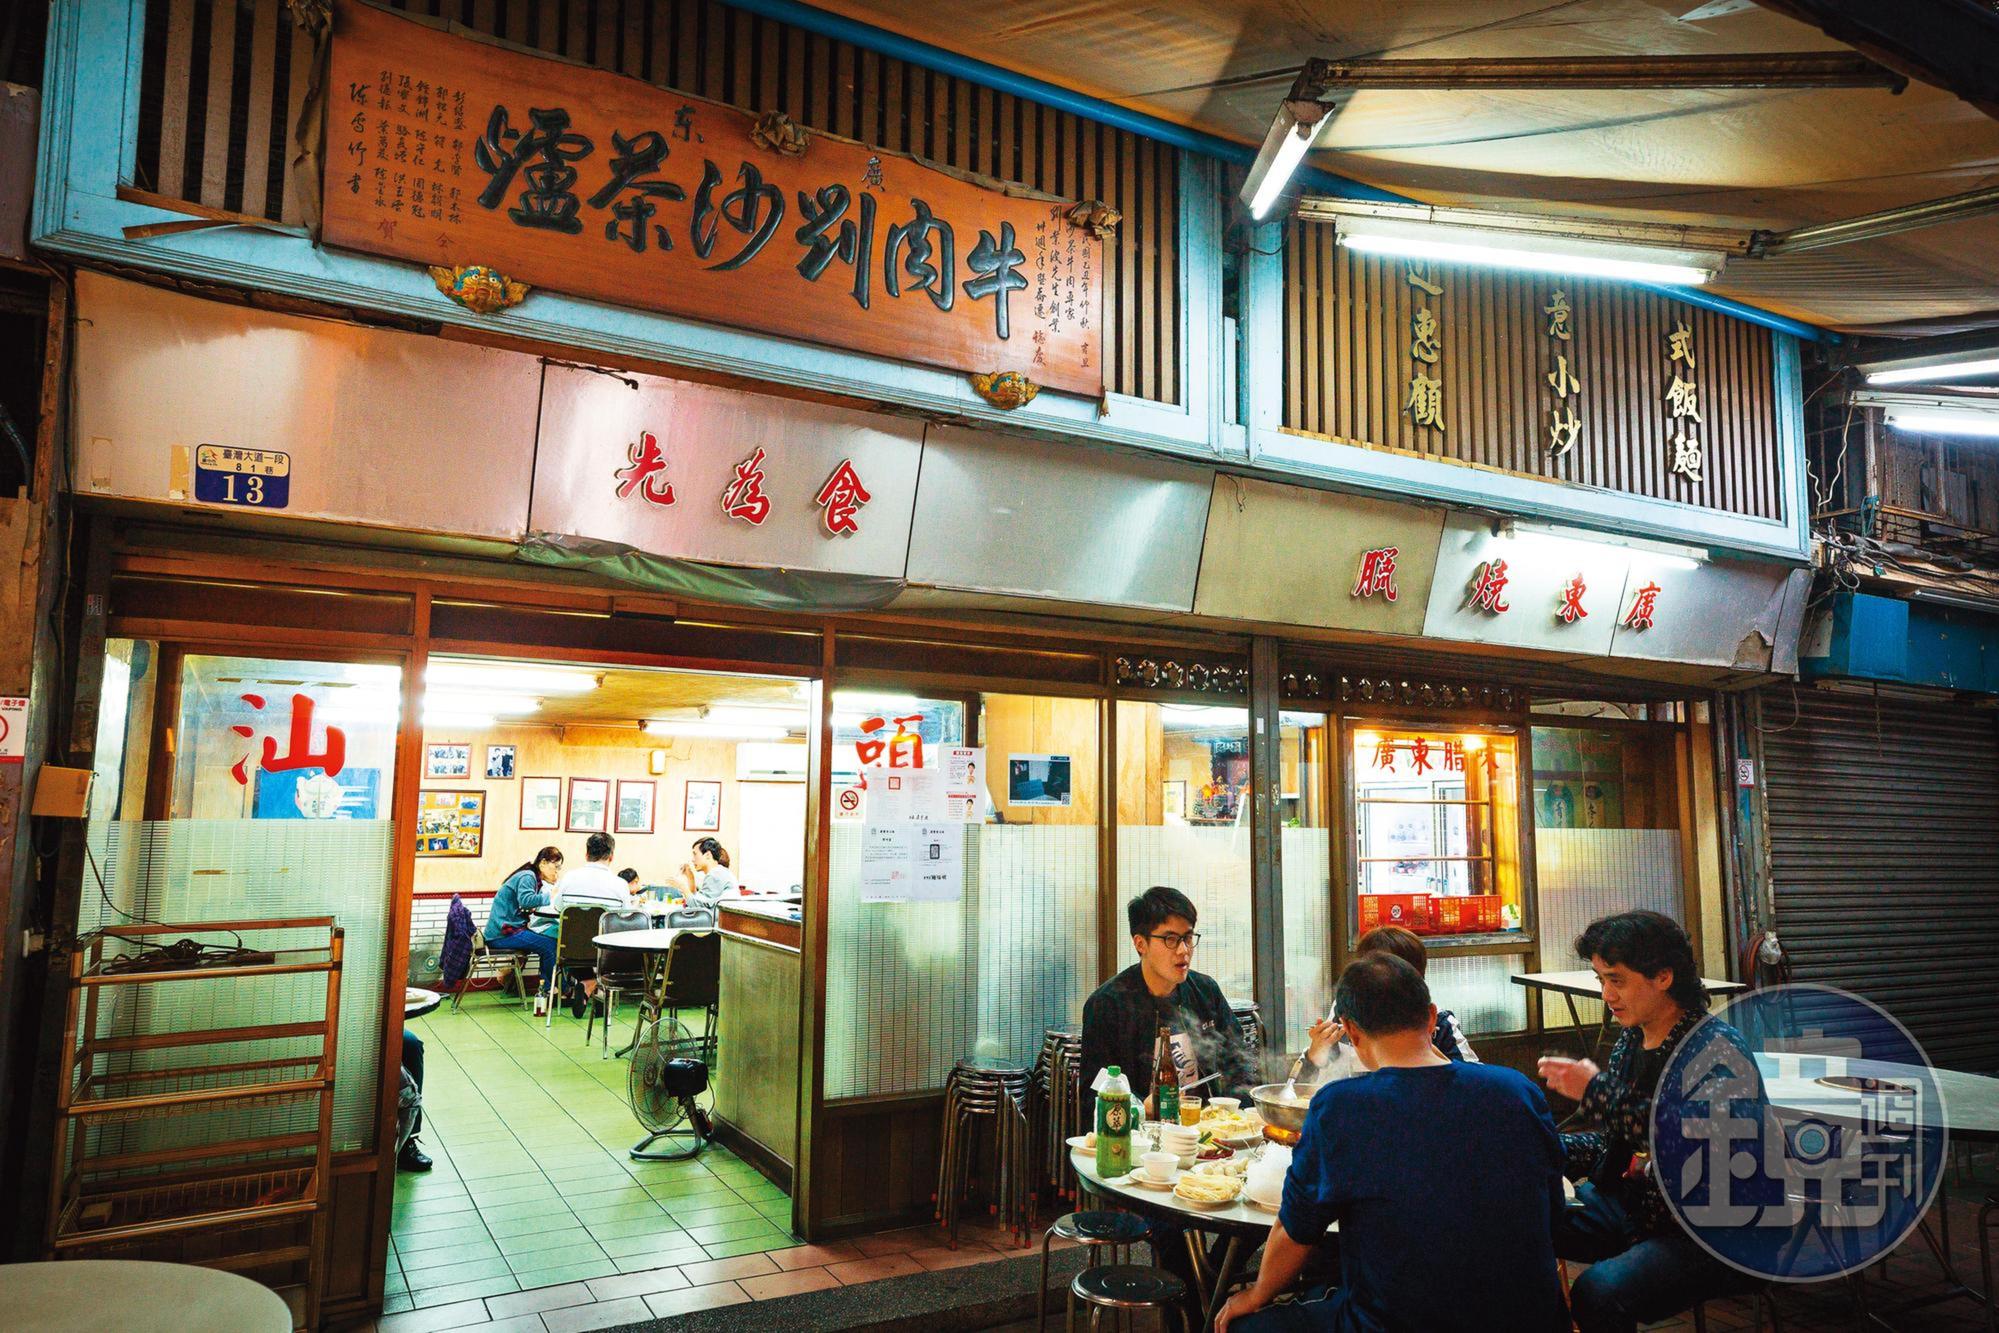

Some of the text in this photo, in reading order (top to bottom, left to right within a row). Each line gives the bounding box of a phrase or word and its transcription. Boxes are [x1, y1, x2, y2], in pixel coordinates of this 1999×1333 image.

[223, 449, 284, 464] 臺灣大道一段
[223, 475, 264, 504] 13
[230, 693, 346, 786] 汕
